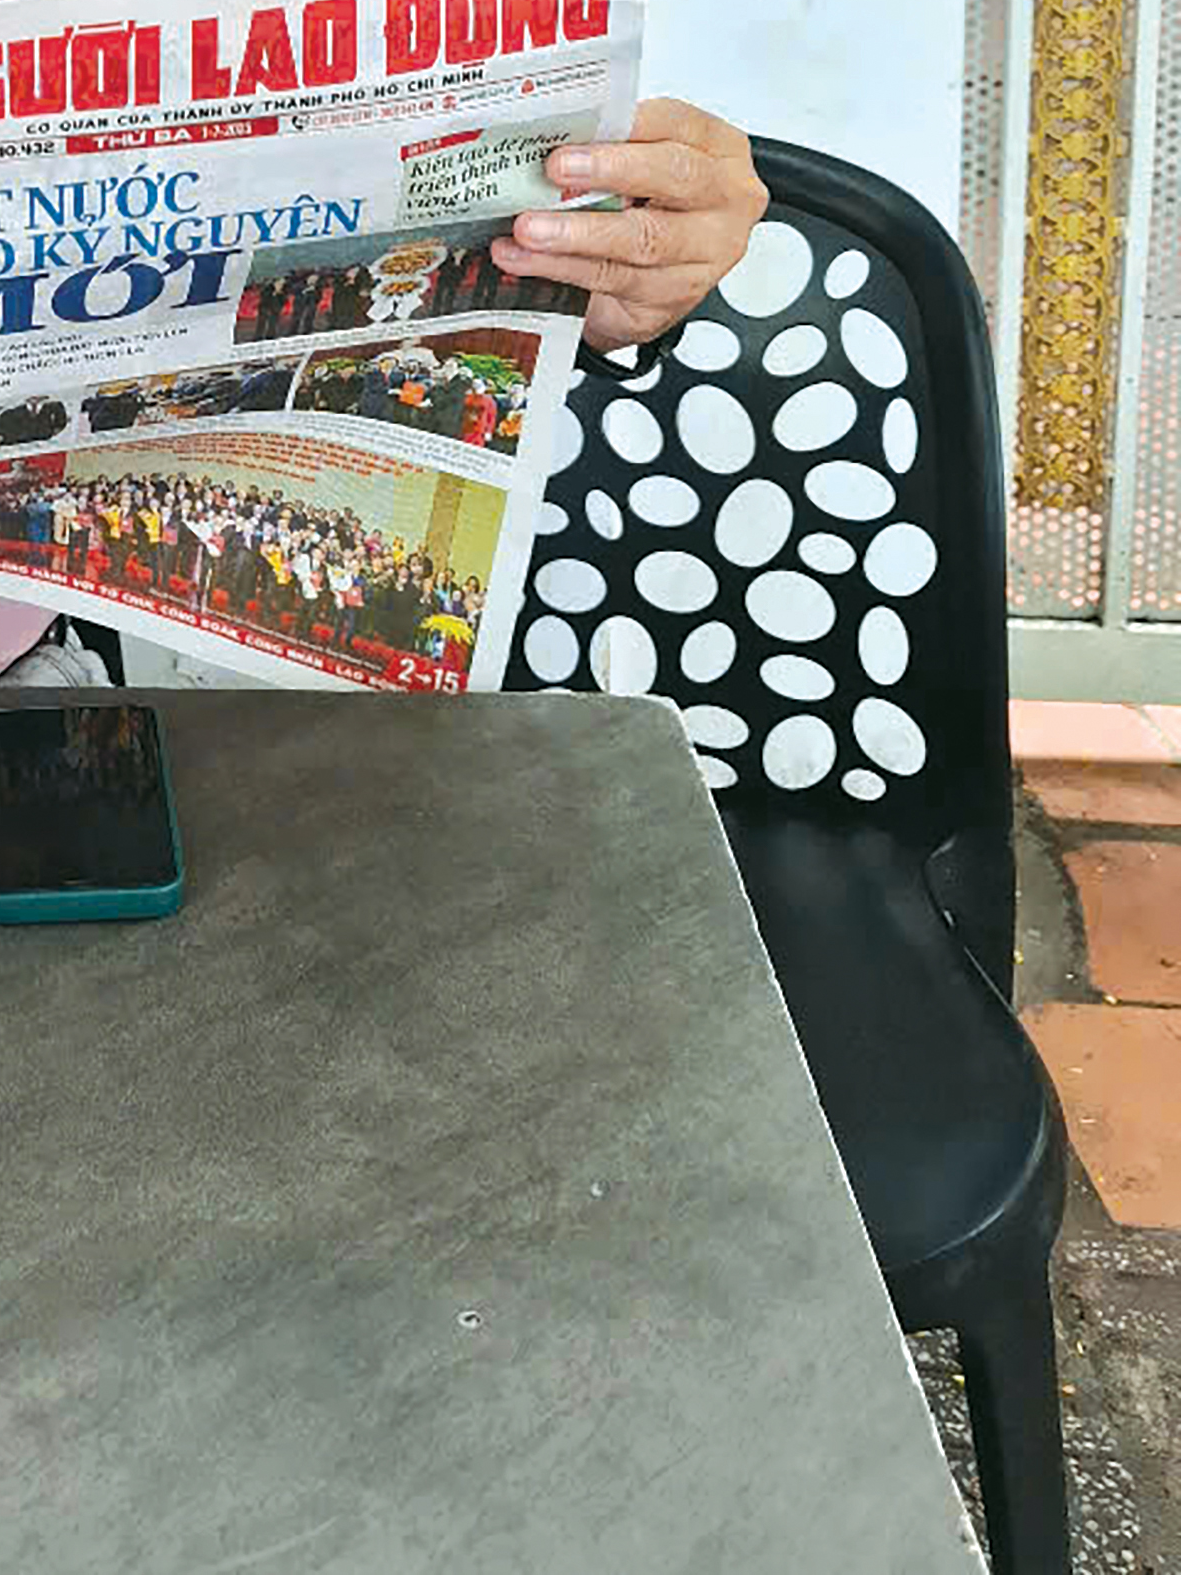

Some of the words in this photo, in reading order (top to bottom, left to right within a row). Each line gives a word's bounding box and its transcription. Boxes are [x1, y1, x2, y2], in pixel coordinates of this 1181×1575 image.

[59, 116, 110, 132] QUAN
[442, 69, 484, 86] MINH
[92, 128, 146, 152] THỨ
[154, 127, 192, 144] BA
[24, 163, 200, 230] NƯỚC
[123, 193, 367, 259] NGUYÊN
